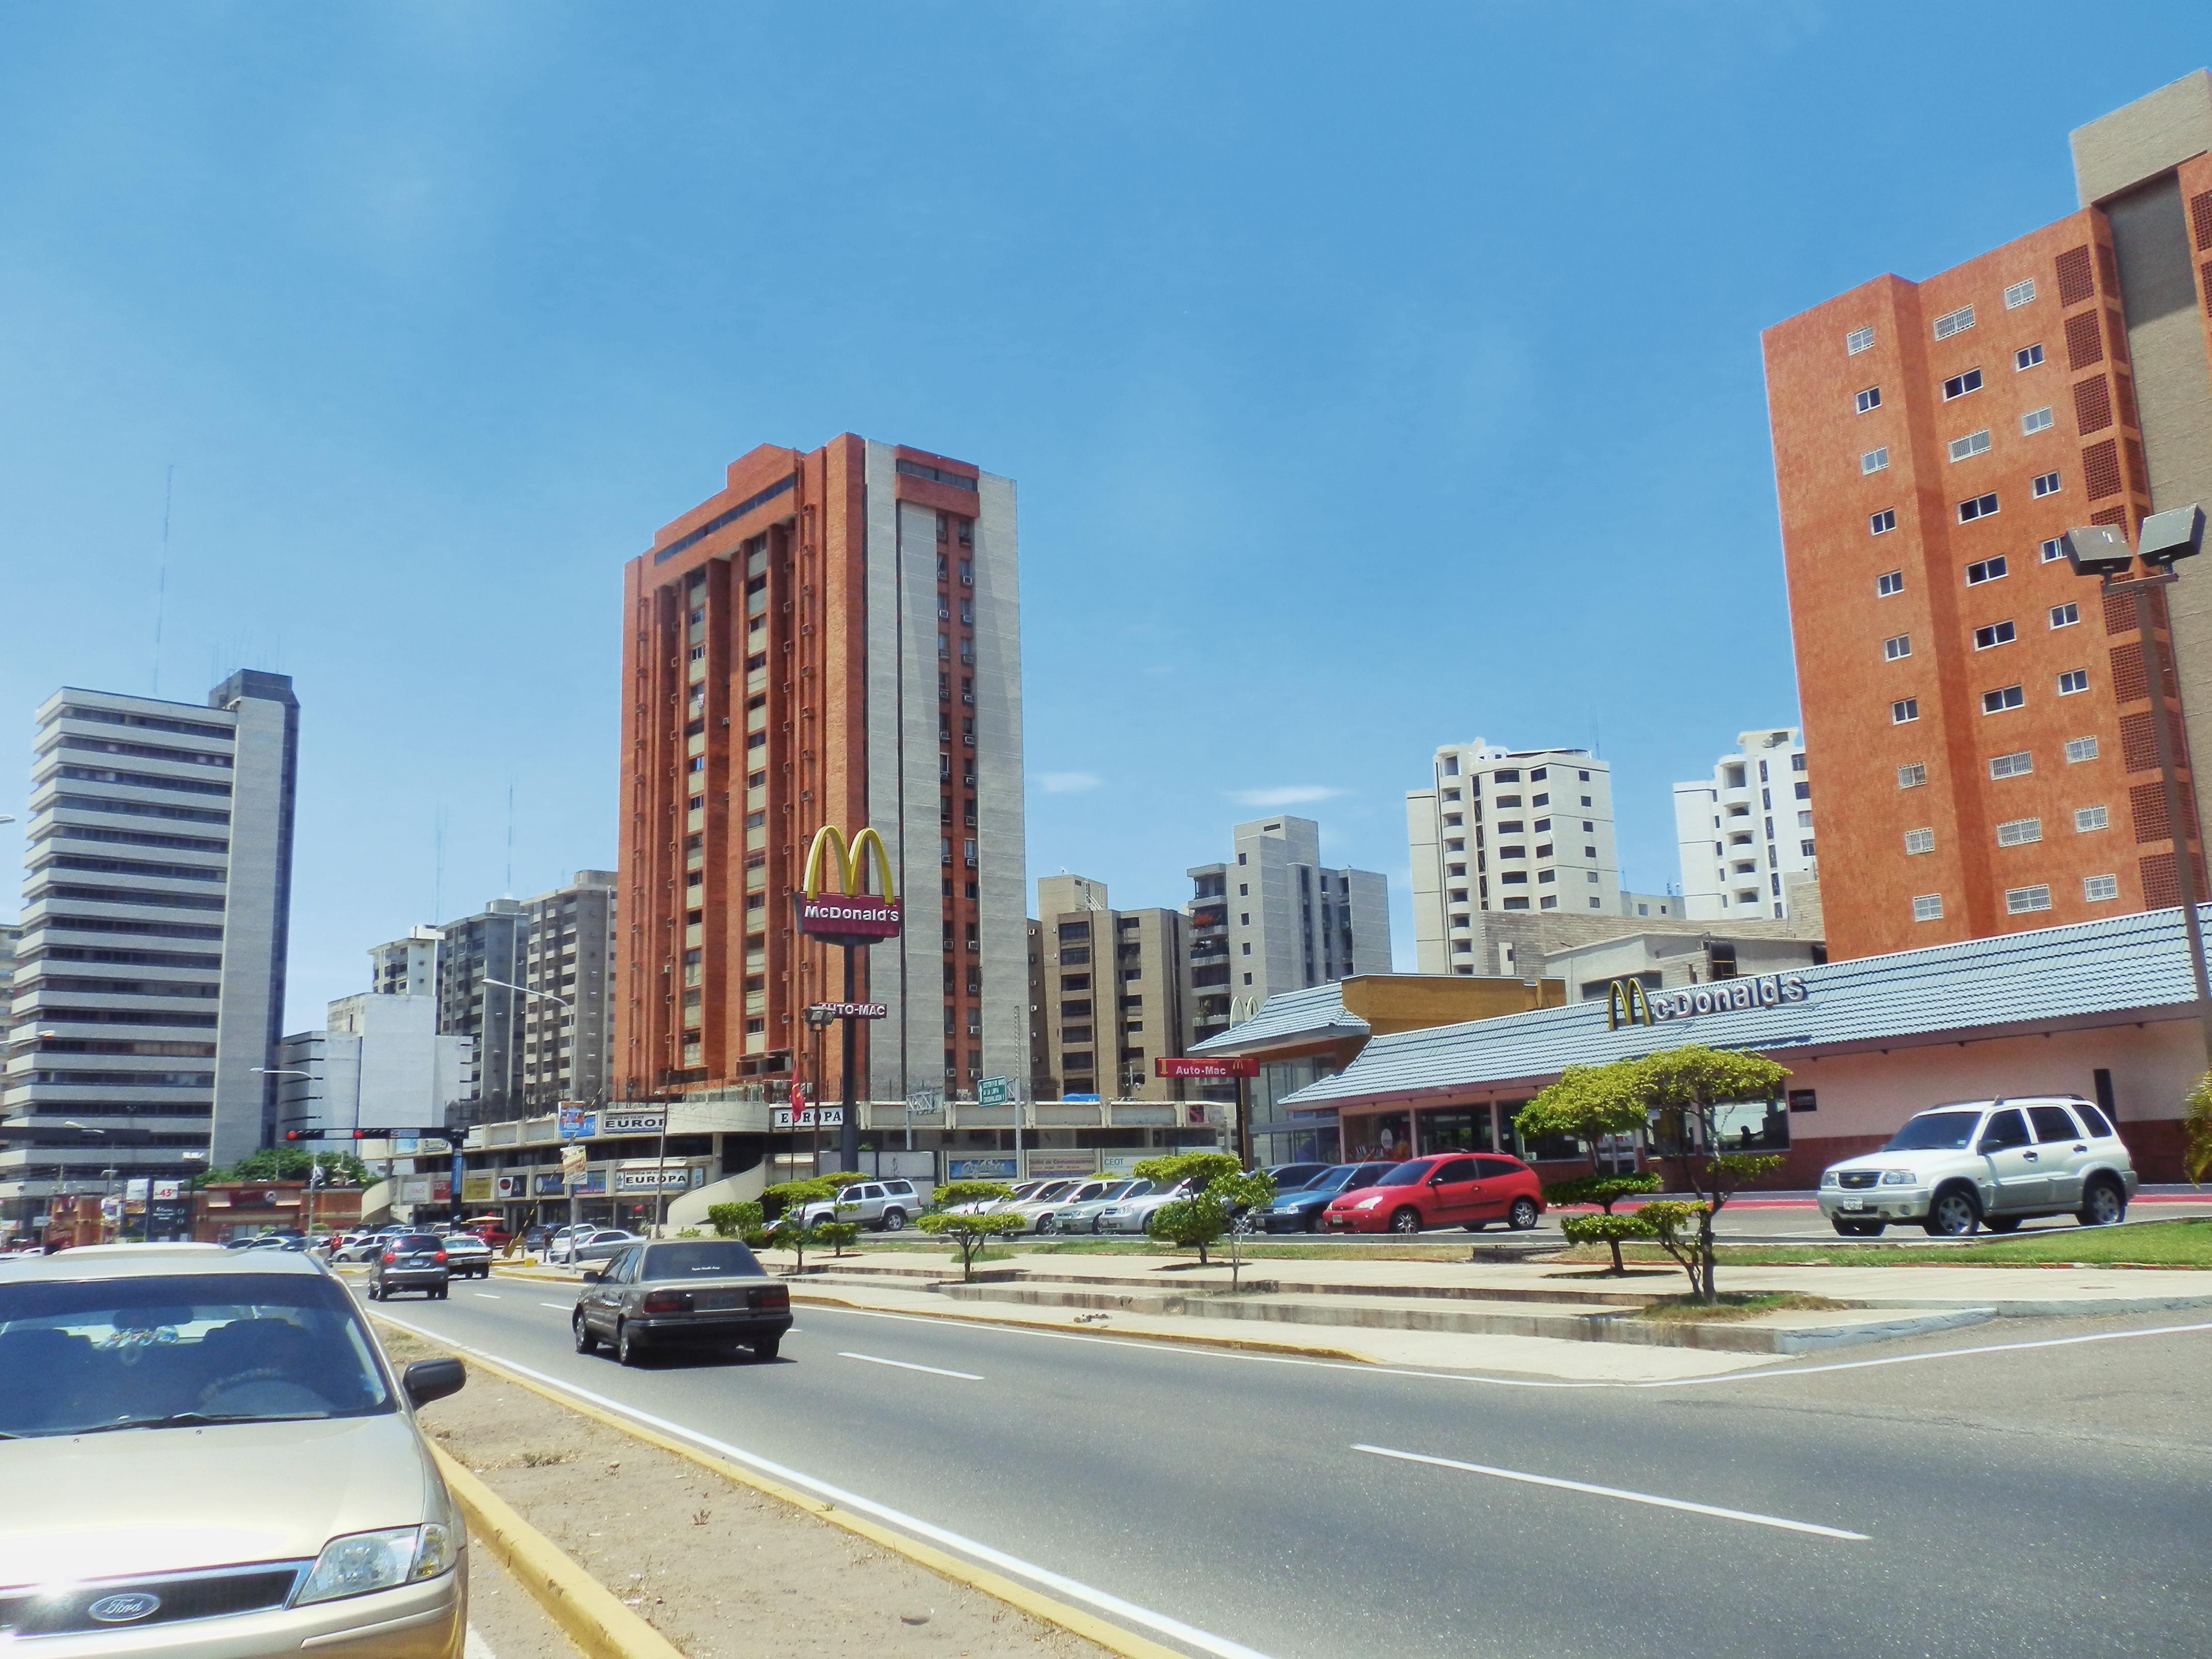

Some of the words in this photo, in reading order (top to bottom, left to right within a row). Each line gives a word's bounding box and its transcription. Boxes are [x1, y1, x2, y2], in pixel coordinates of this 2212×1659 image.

[804, 905, 899, 922] McDonald's
[1176, 1066, 1226, 1075] Auto-Mac
[781, 1111, 842, 1123] ERPA
[626, 1175, 686, 1184] EUROPA
[102, 1598, 144, 1615] Ford
